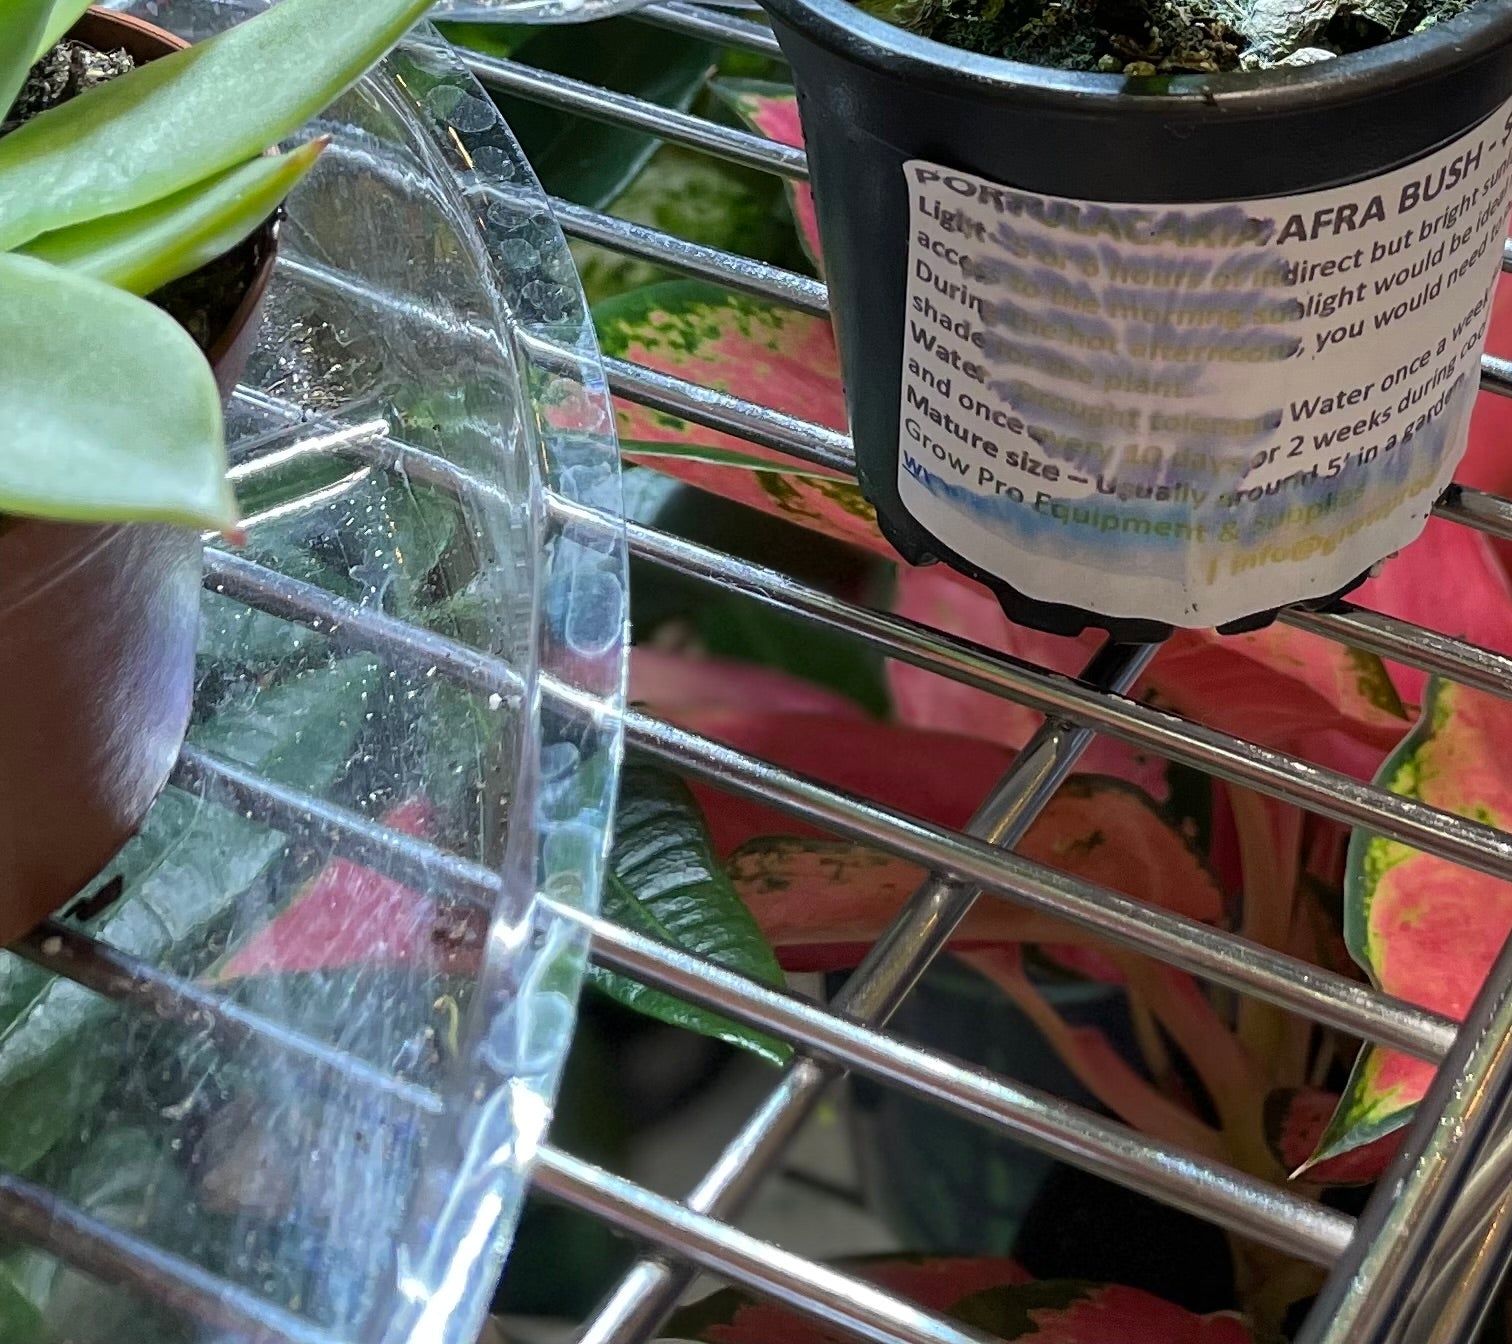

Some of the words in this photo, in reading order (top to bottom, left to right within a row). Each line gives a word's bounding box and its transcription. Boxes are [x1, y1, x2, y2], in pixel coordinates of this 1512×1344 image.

[919, 195, 986, 243] Light
[1371, 229, 1414, 265] but
[1419, 188, 1479, 244] bright
[1277, 196, 1386, 245] AFRA
[1398, 142, 1483, 215] BUSH
[1375, 241, 1445, 297] would
[1449, 223, 1472, 256] be
[1475, 175, 1510, 233] ideal
[913, 295, 986, 350] shade
[1316, 319, 1364, 354] you
[1374, 275, 1442, 330] would
[1446, 233, 1489, 289] need
[908, 357, 952, 399] and
[958, 394, 1025, 436] once
[1250, 444, 1281, 470] or
[1287, 435, 1306, 459] 2
[1314, 407, 1393, 452] weeks
[1397, 357, 1457, 415] during
[1290, 382, 1375, 423] Water
[1381, 350, 1431, 393] once
[1436, 337, 1447, 355] a
[905, 417, 971, 475] Grow
[979, 466, 1025, 504] Pro
[1034, 491, 1209, 544] Equipment
[1219, 519, 1240, 544] &
[906, 384, 999, 459] Mature
[1005, 451, 1061, 482] size
[1358, 445, 1378, 467] in
[1385, 434, 1398, 451] a
